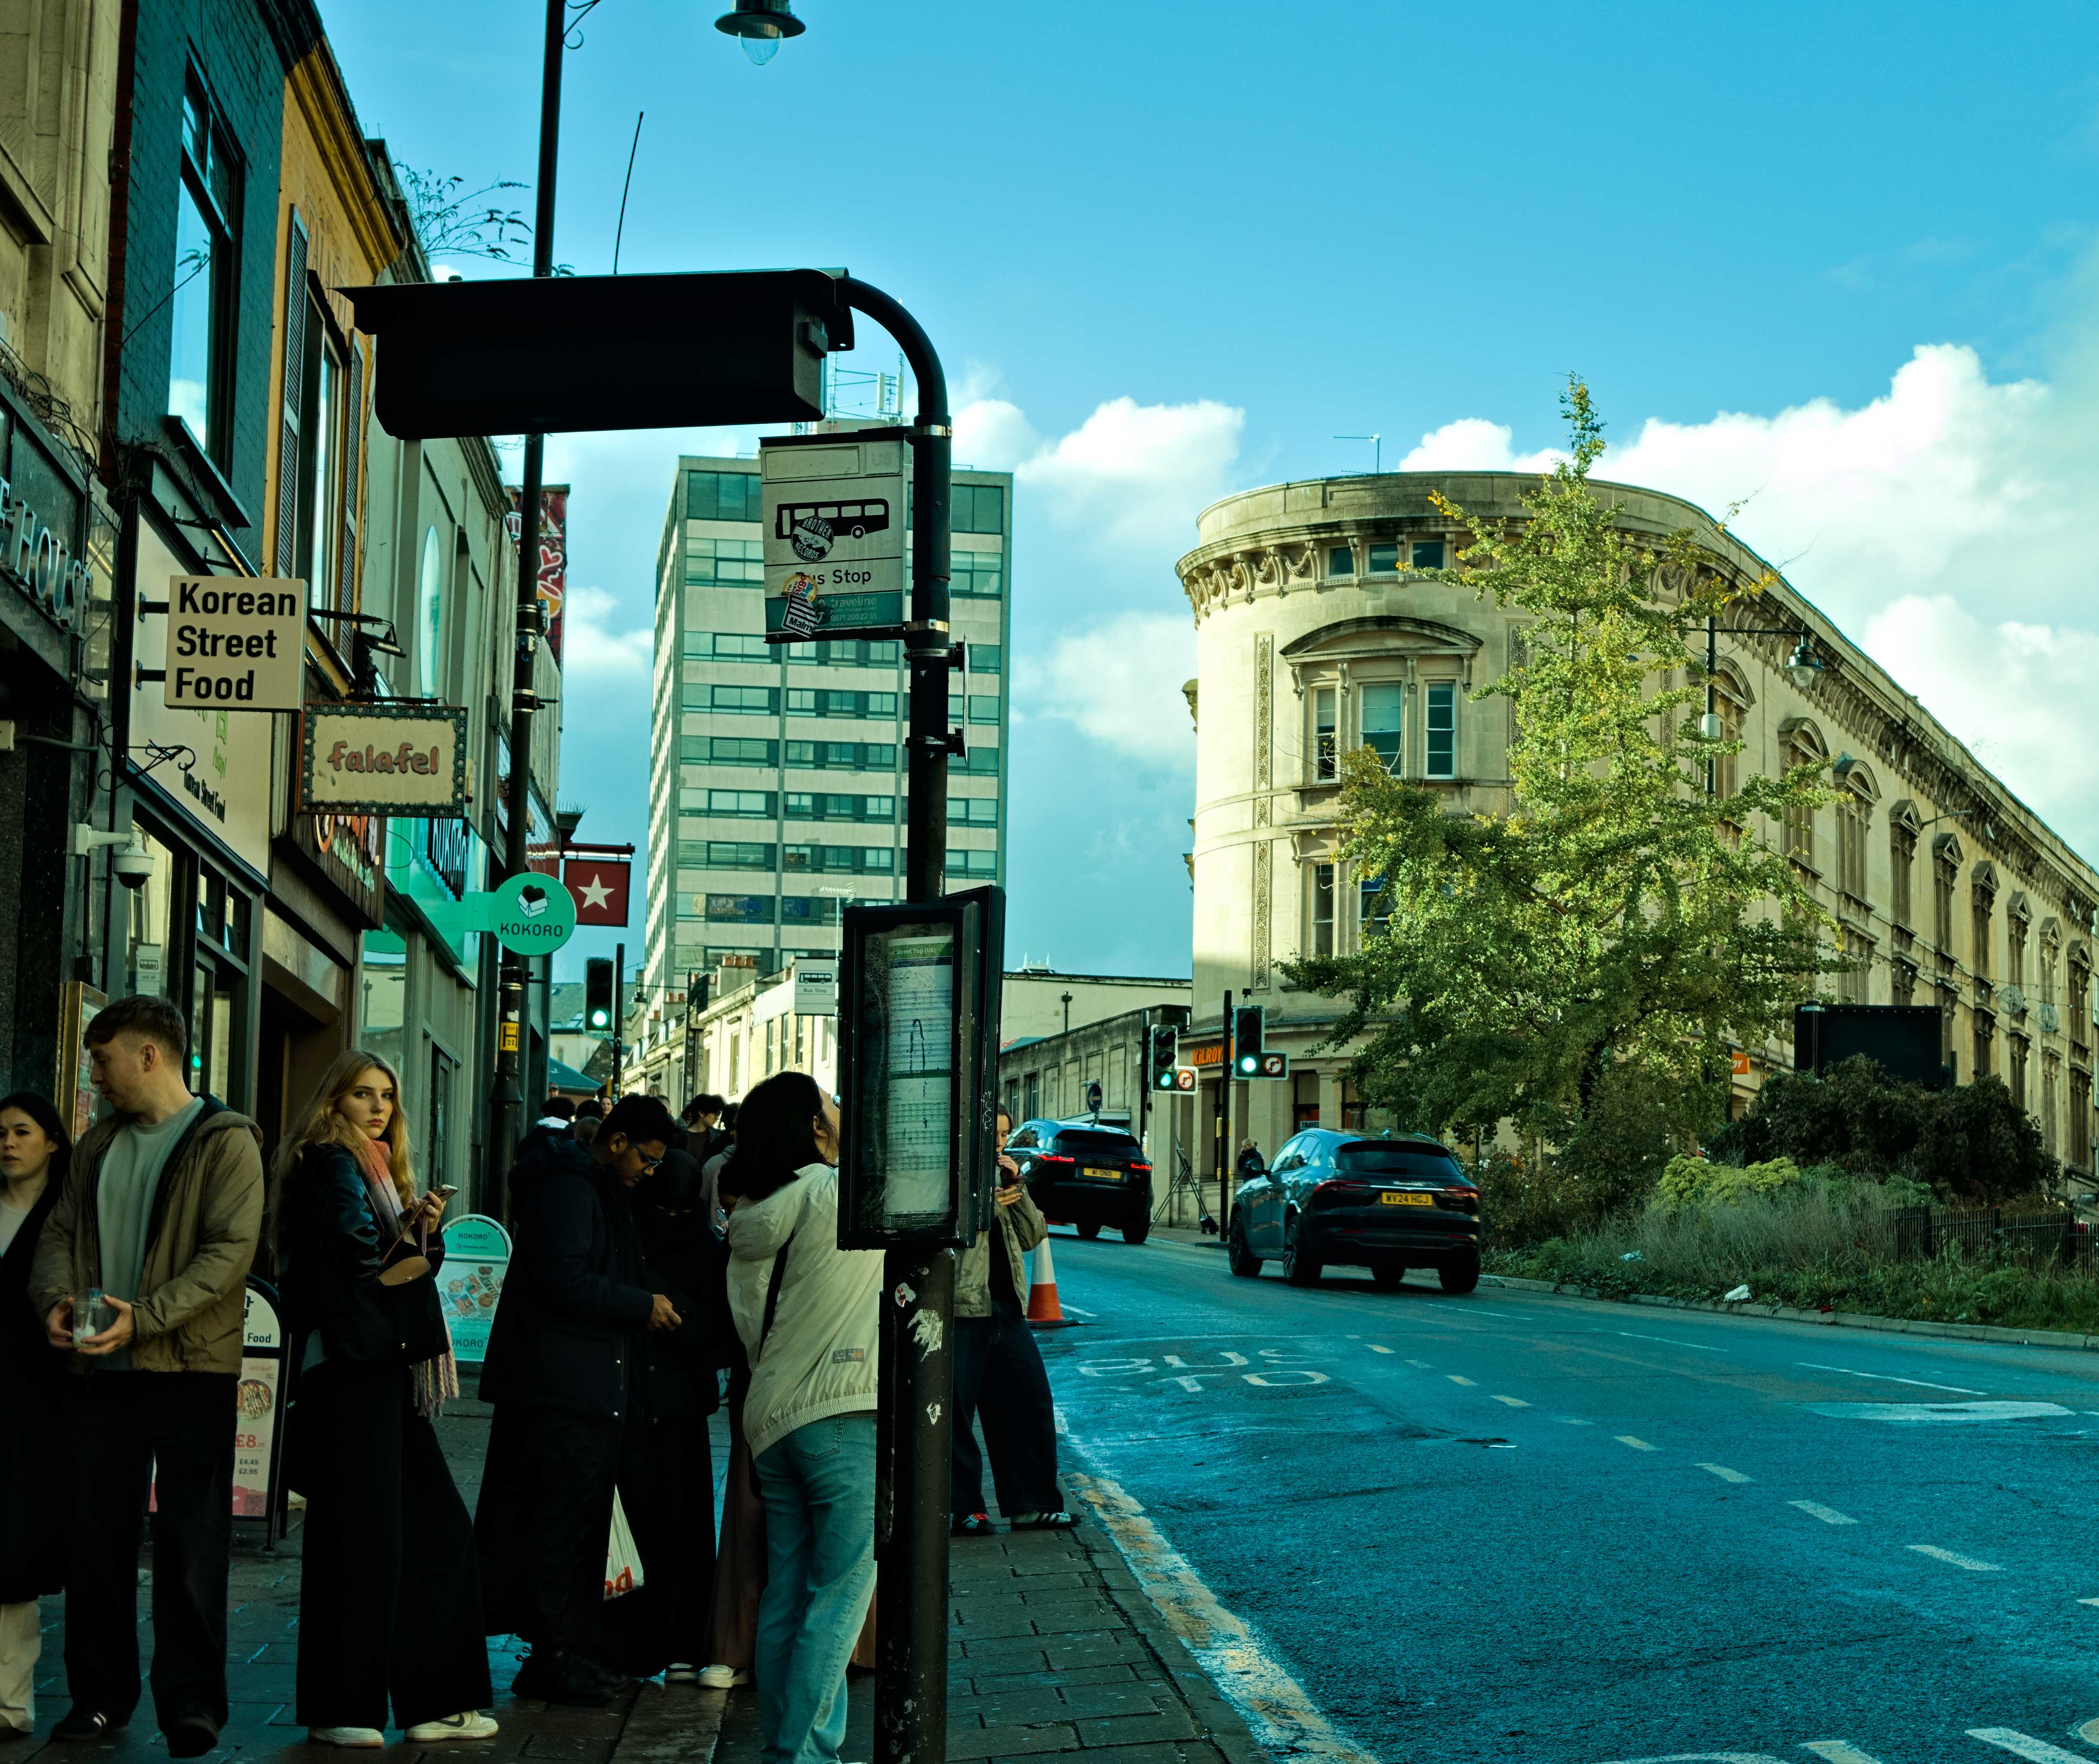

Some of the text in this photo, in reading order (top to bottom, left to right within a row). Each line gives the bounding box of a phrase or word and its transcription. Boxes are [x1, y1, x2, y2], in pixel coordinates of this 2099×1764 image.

[802, 518, 832, 539] BROTHER
[795, 542, 820, 559] RECORDS
[833, 569, 871, 584] Stop
[179, 583, 296, 616] Korean
[831, 595, 877, 607] traveline
[177, 625, 277, 658] Street
[176, 667, 254, 700] Food
[328, 740, 440, 774] falafel
[500, 922, 563, 937] KOKORO
[247, 1332, 271, 1343] Food
[1076, 1349, 1339, 1377] BUS
